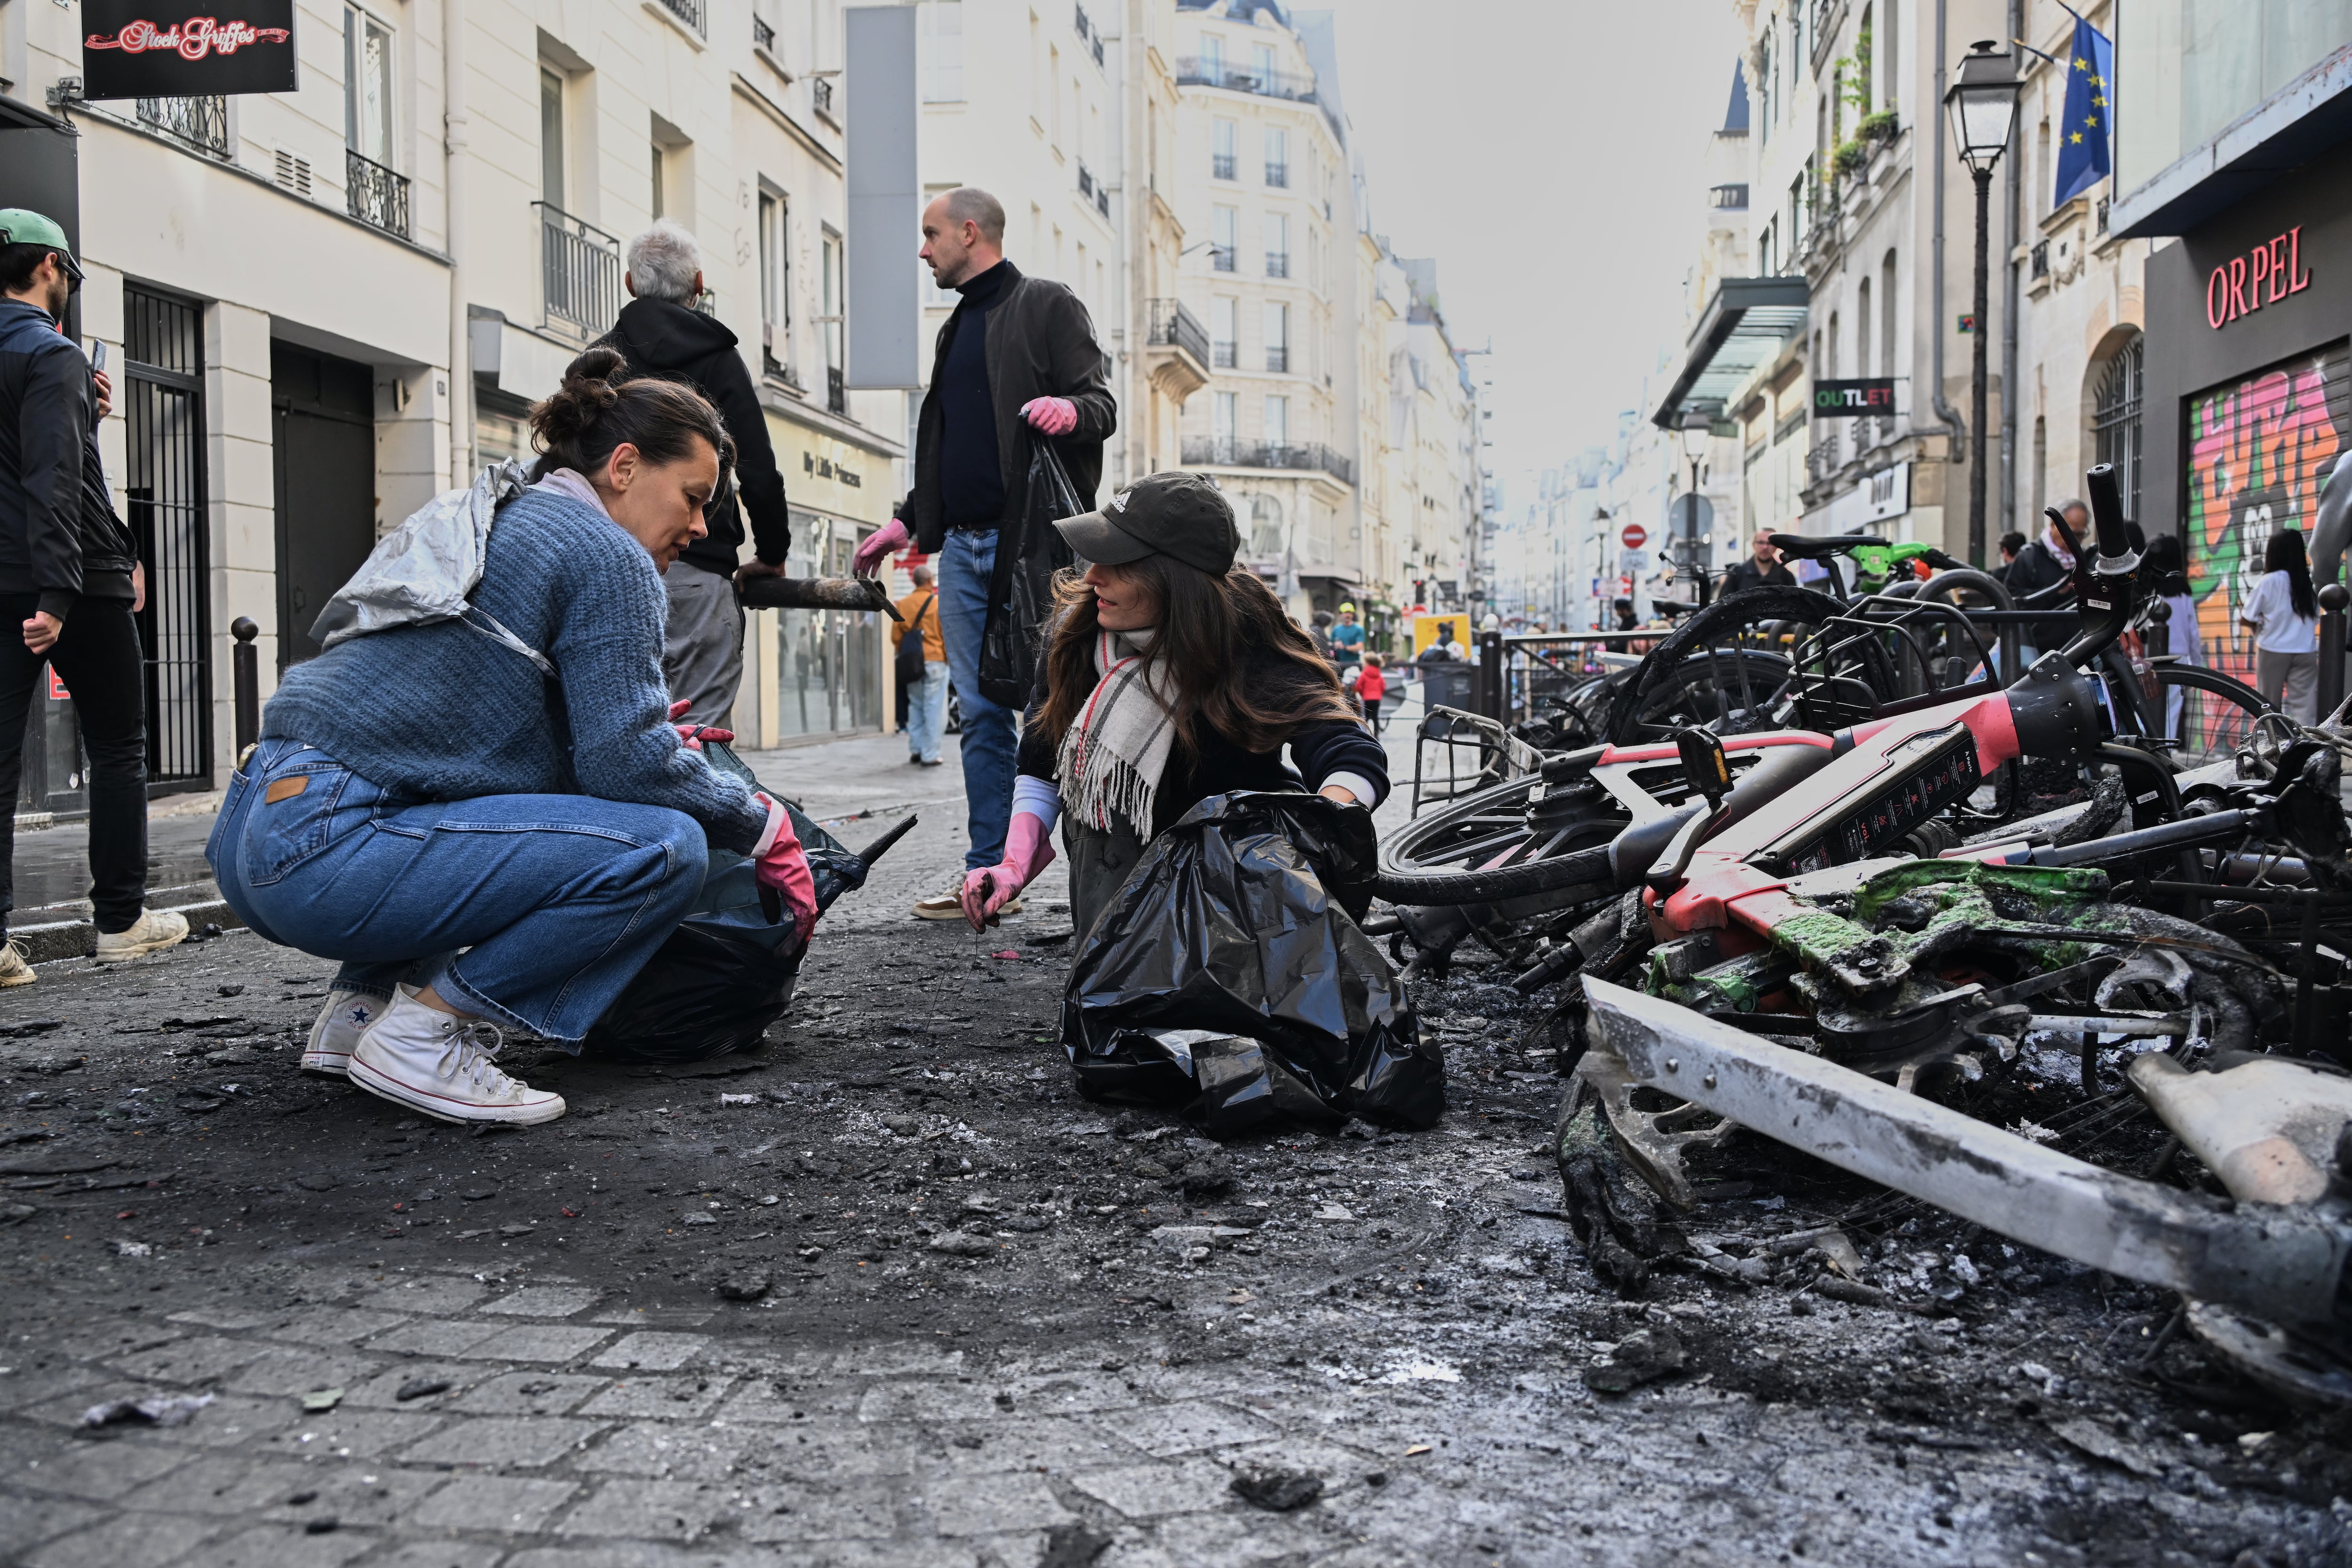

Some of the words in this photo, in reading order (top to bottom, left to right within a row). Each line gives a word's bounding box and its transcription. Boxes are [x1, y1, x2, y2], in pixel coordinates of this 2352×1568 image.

[120, 21, 180, 51] Stock
[180, 19, 255, 59] Griffes
[2207, 224, 2310, 329] ORPEL
[1816, 388, 1891, 407] OUTLET
[816, 454, 832, 479] Little
[834, 462, 860, 488] Princess
[349, 1002, 373, 1013] CONVERSE
